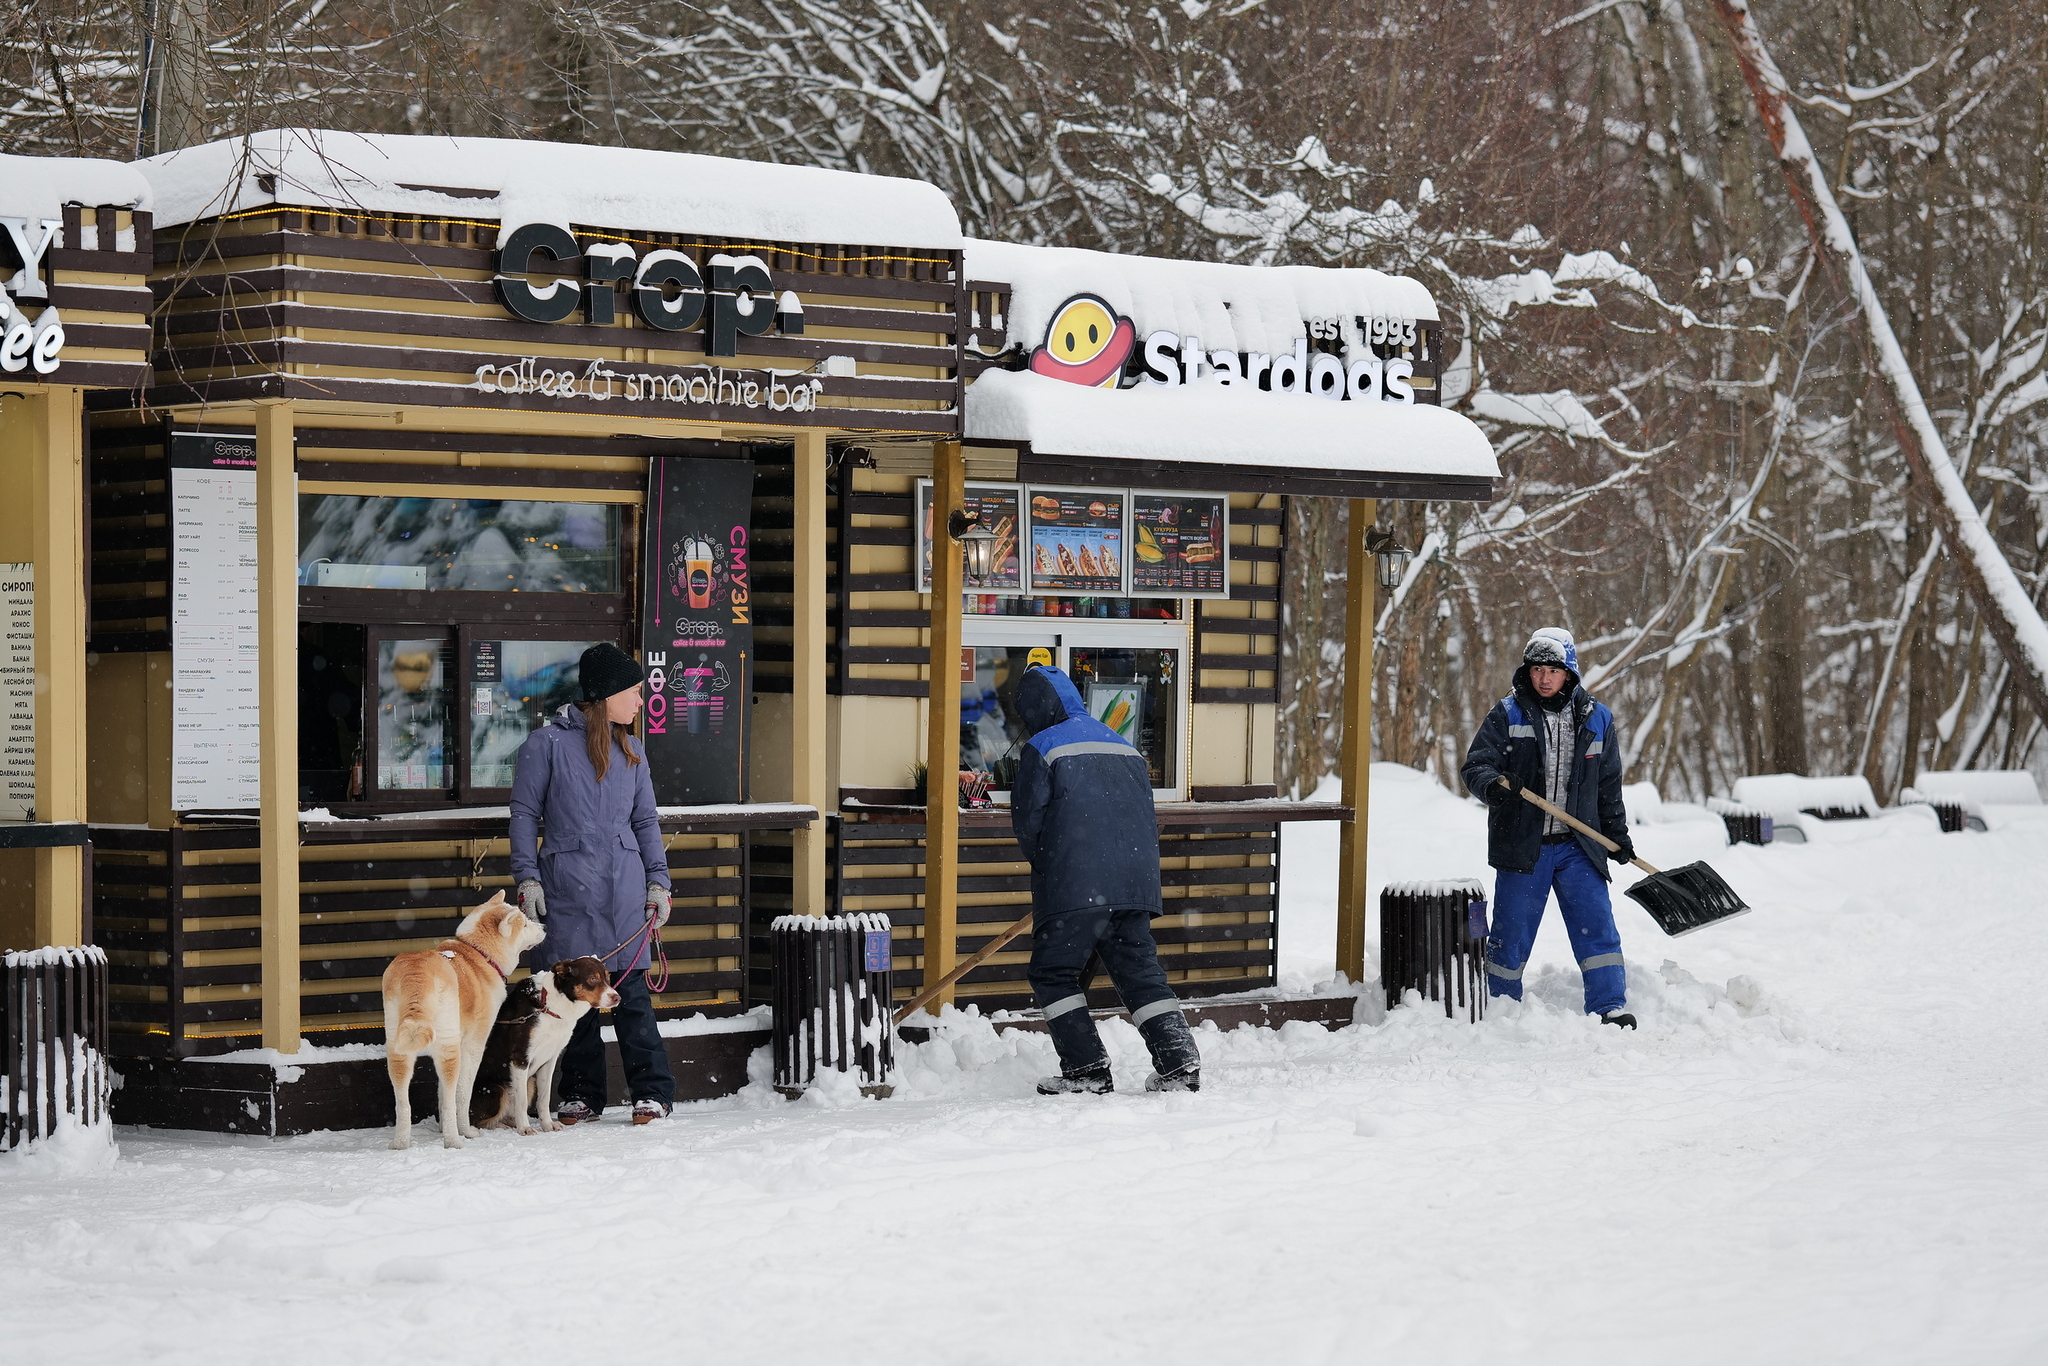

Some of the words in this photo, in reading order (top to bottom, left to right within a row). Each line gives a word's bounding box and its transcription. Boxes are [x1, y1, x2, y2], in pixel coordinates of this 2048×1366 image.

[475, 357, 577, 398] coffee
[624, 366, 760, 408] smoothie
[766, 370, 822, 412] bar
[215, 441, 256, 459] Crop.
[730, 526, 749, 624] СМУЗИ
[676, 617, 724, 638] Crop.
[648, 651, 666, 734] КОФЕ
